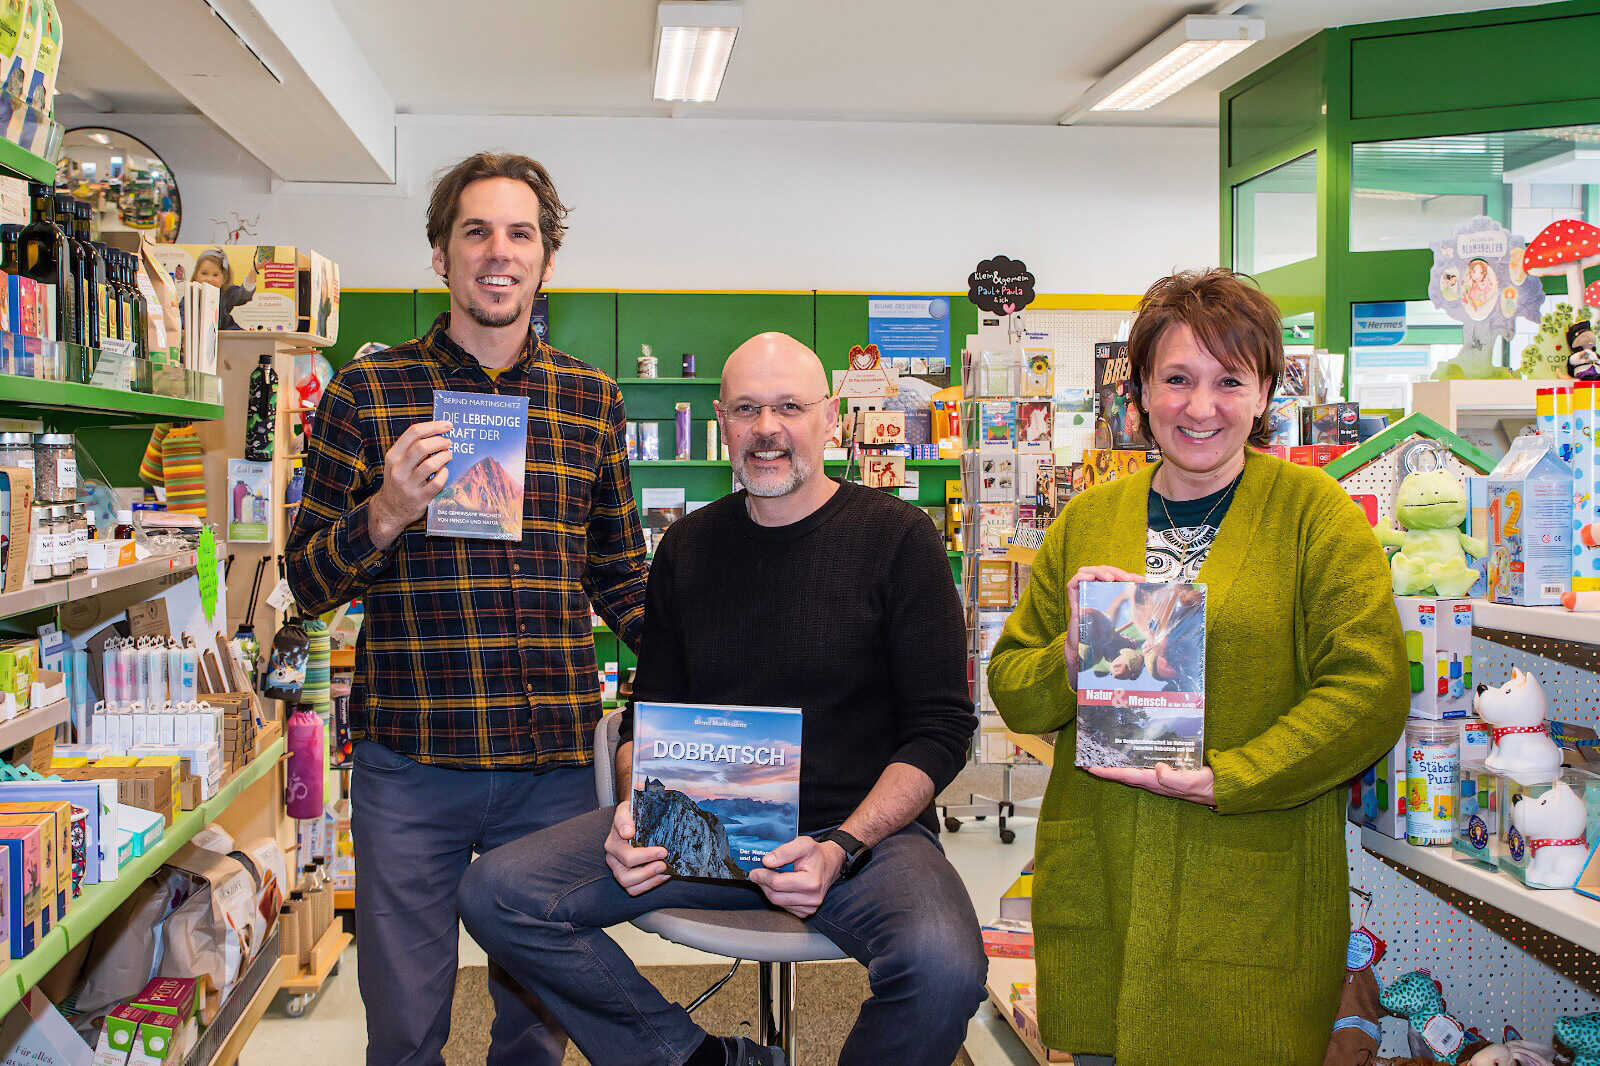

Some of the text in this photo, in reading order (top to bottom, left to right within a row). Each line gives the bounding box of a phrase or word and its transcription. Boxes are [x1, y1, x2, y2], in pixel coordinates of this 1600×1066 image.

[977, 285, 995, 296] Paul
[1001, 285, 1024, 296] Paula
[1367, 320, 1404, 329] Hermes
[443, 397, 467, 405] BERND
[442, 411, 521, 428] DIE LEBENDIGE
[479, 429, 500, 441] DER
[1086, 689, 1113, 701] Natur
[1128, 695, 1167, 707] Mensch
[652, 739, 786, 767] DOBRATSCH
[15, 1045, 32, 1058] Für
